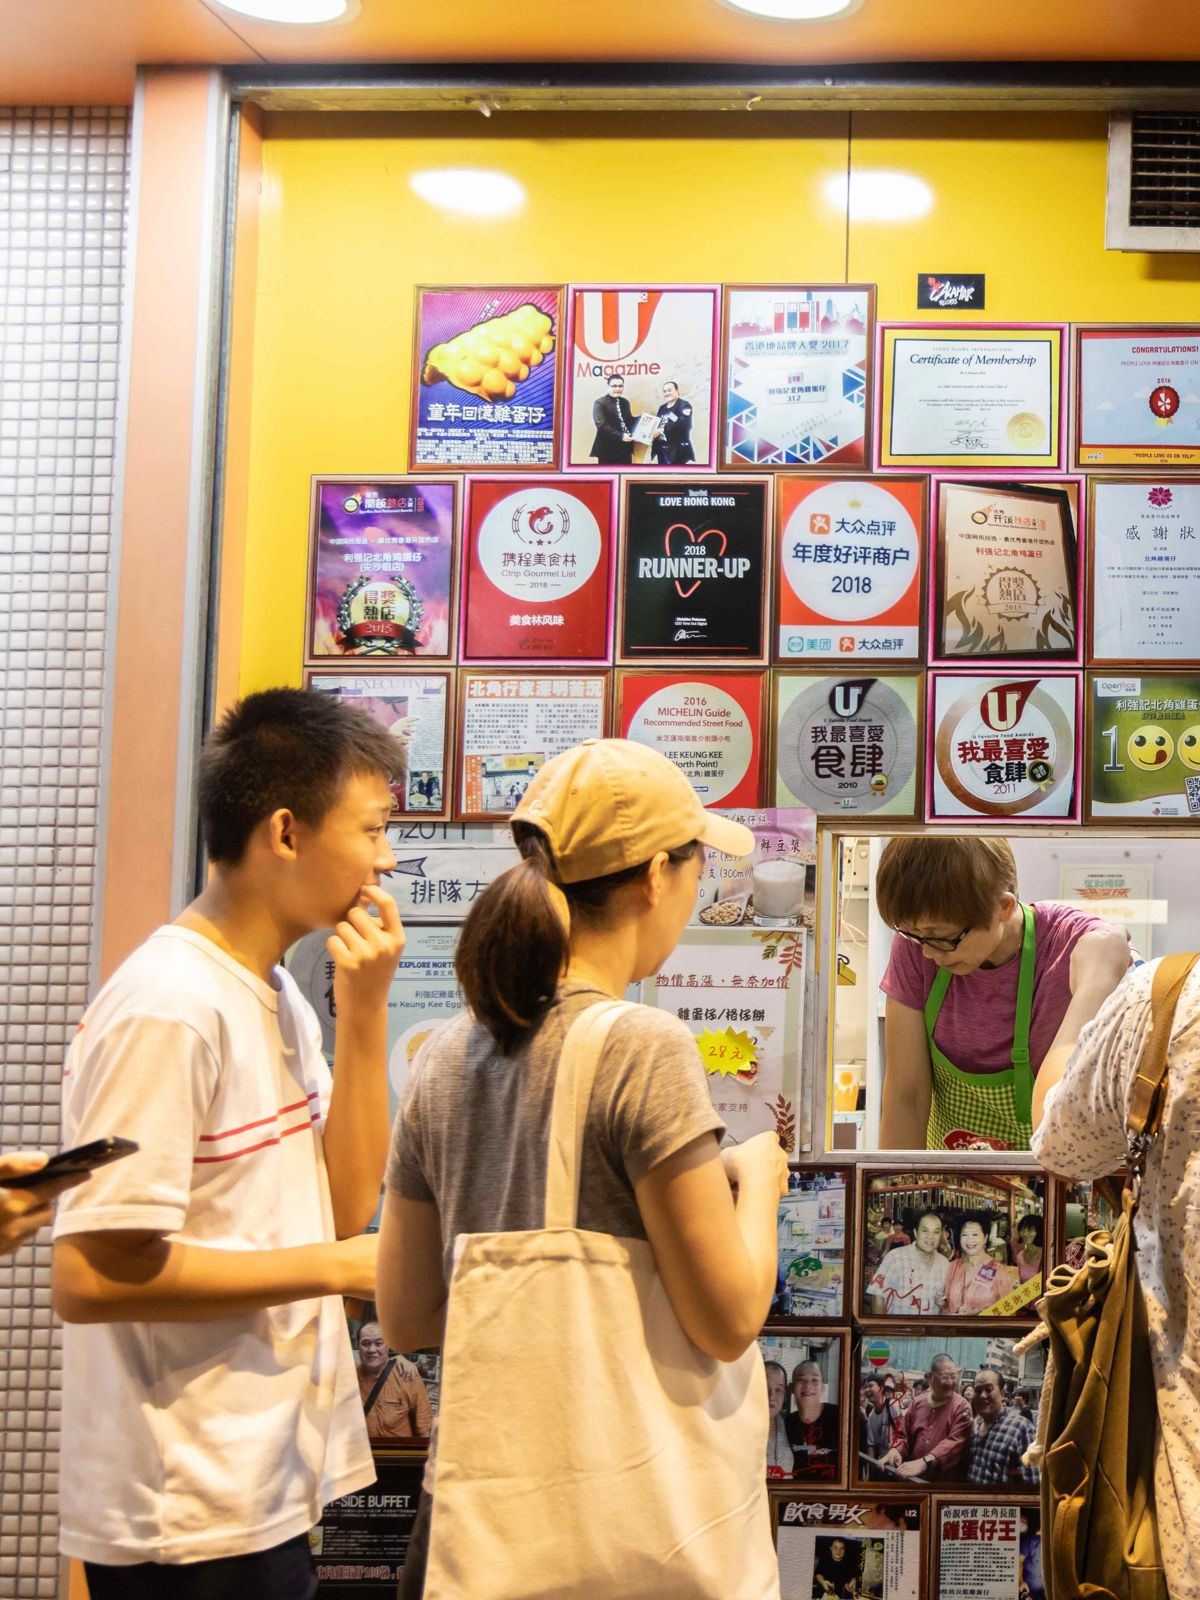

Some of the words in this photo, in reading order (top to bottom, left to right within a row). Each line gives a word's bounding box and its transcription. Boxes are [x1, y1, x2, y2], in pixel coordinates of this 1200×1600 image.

[1131, 345, 1199, 354] CONGRATULATIONS!
[910, 354, 960, 366] Certificate
[962, 354, 974, 367] of
[975, 354, 1037, 367] Membership
[577, 359, 661, 380] Magazine
[427, 403, 546, 424] 童年回憶雞蛋仔
[660, 497, 682, 507] LOVE
[684, 497, 709, 507] HONG
[711, 497, 735, 507] KONG
[835, 517, 896, 536] 大众点评
[1125, 525, 1197, 541] 感謝狀
[684, 545, 706, 556] 2018
[792, 542, 910, 566] 年度好评商户
[502, 551, 577, 568] 携程美食林
[501, 569, 521, 579] Ctrip
[523, 569, 559, 578] Gourmet
[561, 569, 577, 578] List
[638, 557, 751, 579] RUNNER-UP
[529, 581, 548, 589] 2018
[831, 575, 872, 594] 2018
[366, 623, 393, 634] 2015
[858, 638, 904, 650] 大众点评
[353, 678, 432, 690] EXECUTIVE
[684, 696, 707, 706] 2016
[657, 707, 702, 717] MICHELIN
[705, 708, 731, 718] Guide
[643, 718, 700, 727] Recommended
[702, 719, 723, 727] Street
[725, 719, 743, 728] Food
[811, 725, 885, 744] 我最喜愛
[680, 751, 707, 759] KEUNG
[709, 751, 723, 759] KEE
[957, 736, 1050, 764] 我最喜愛
[696, 760, 719, 769] Point)
[810, 743, 884, 779] 食肆
[983, 762, 1027, 785] 食肆
[993, 783, 1016, 795] 2011
[761, 838, 801, 853] 鮮豆漿
[400, 1001, 426, 1009] Keung
[446, 1001, 462, 1009] Egg
[677, 1007, 765, 1022] 雞蛋仔/格仔餅
[368, 1495, 411, 1508] BUFFET
[783, 1501, 872, 1525] 飲食男女
[981, 1507, 1017, 1519] 北角長龍
[943, 1519, 1017, 1541] 雞蛋仔王
